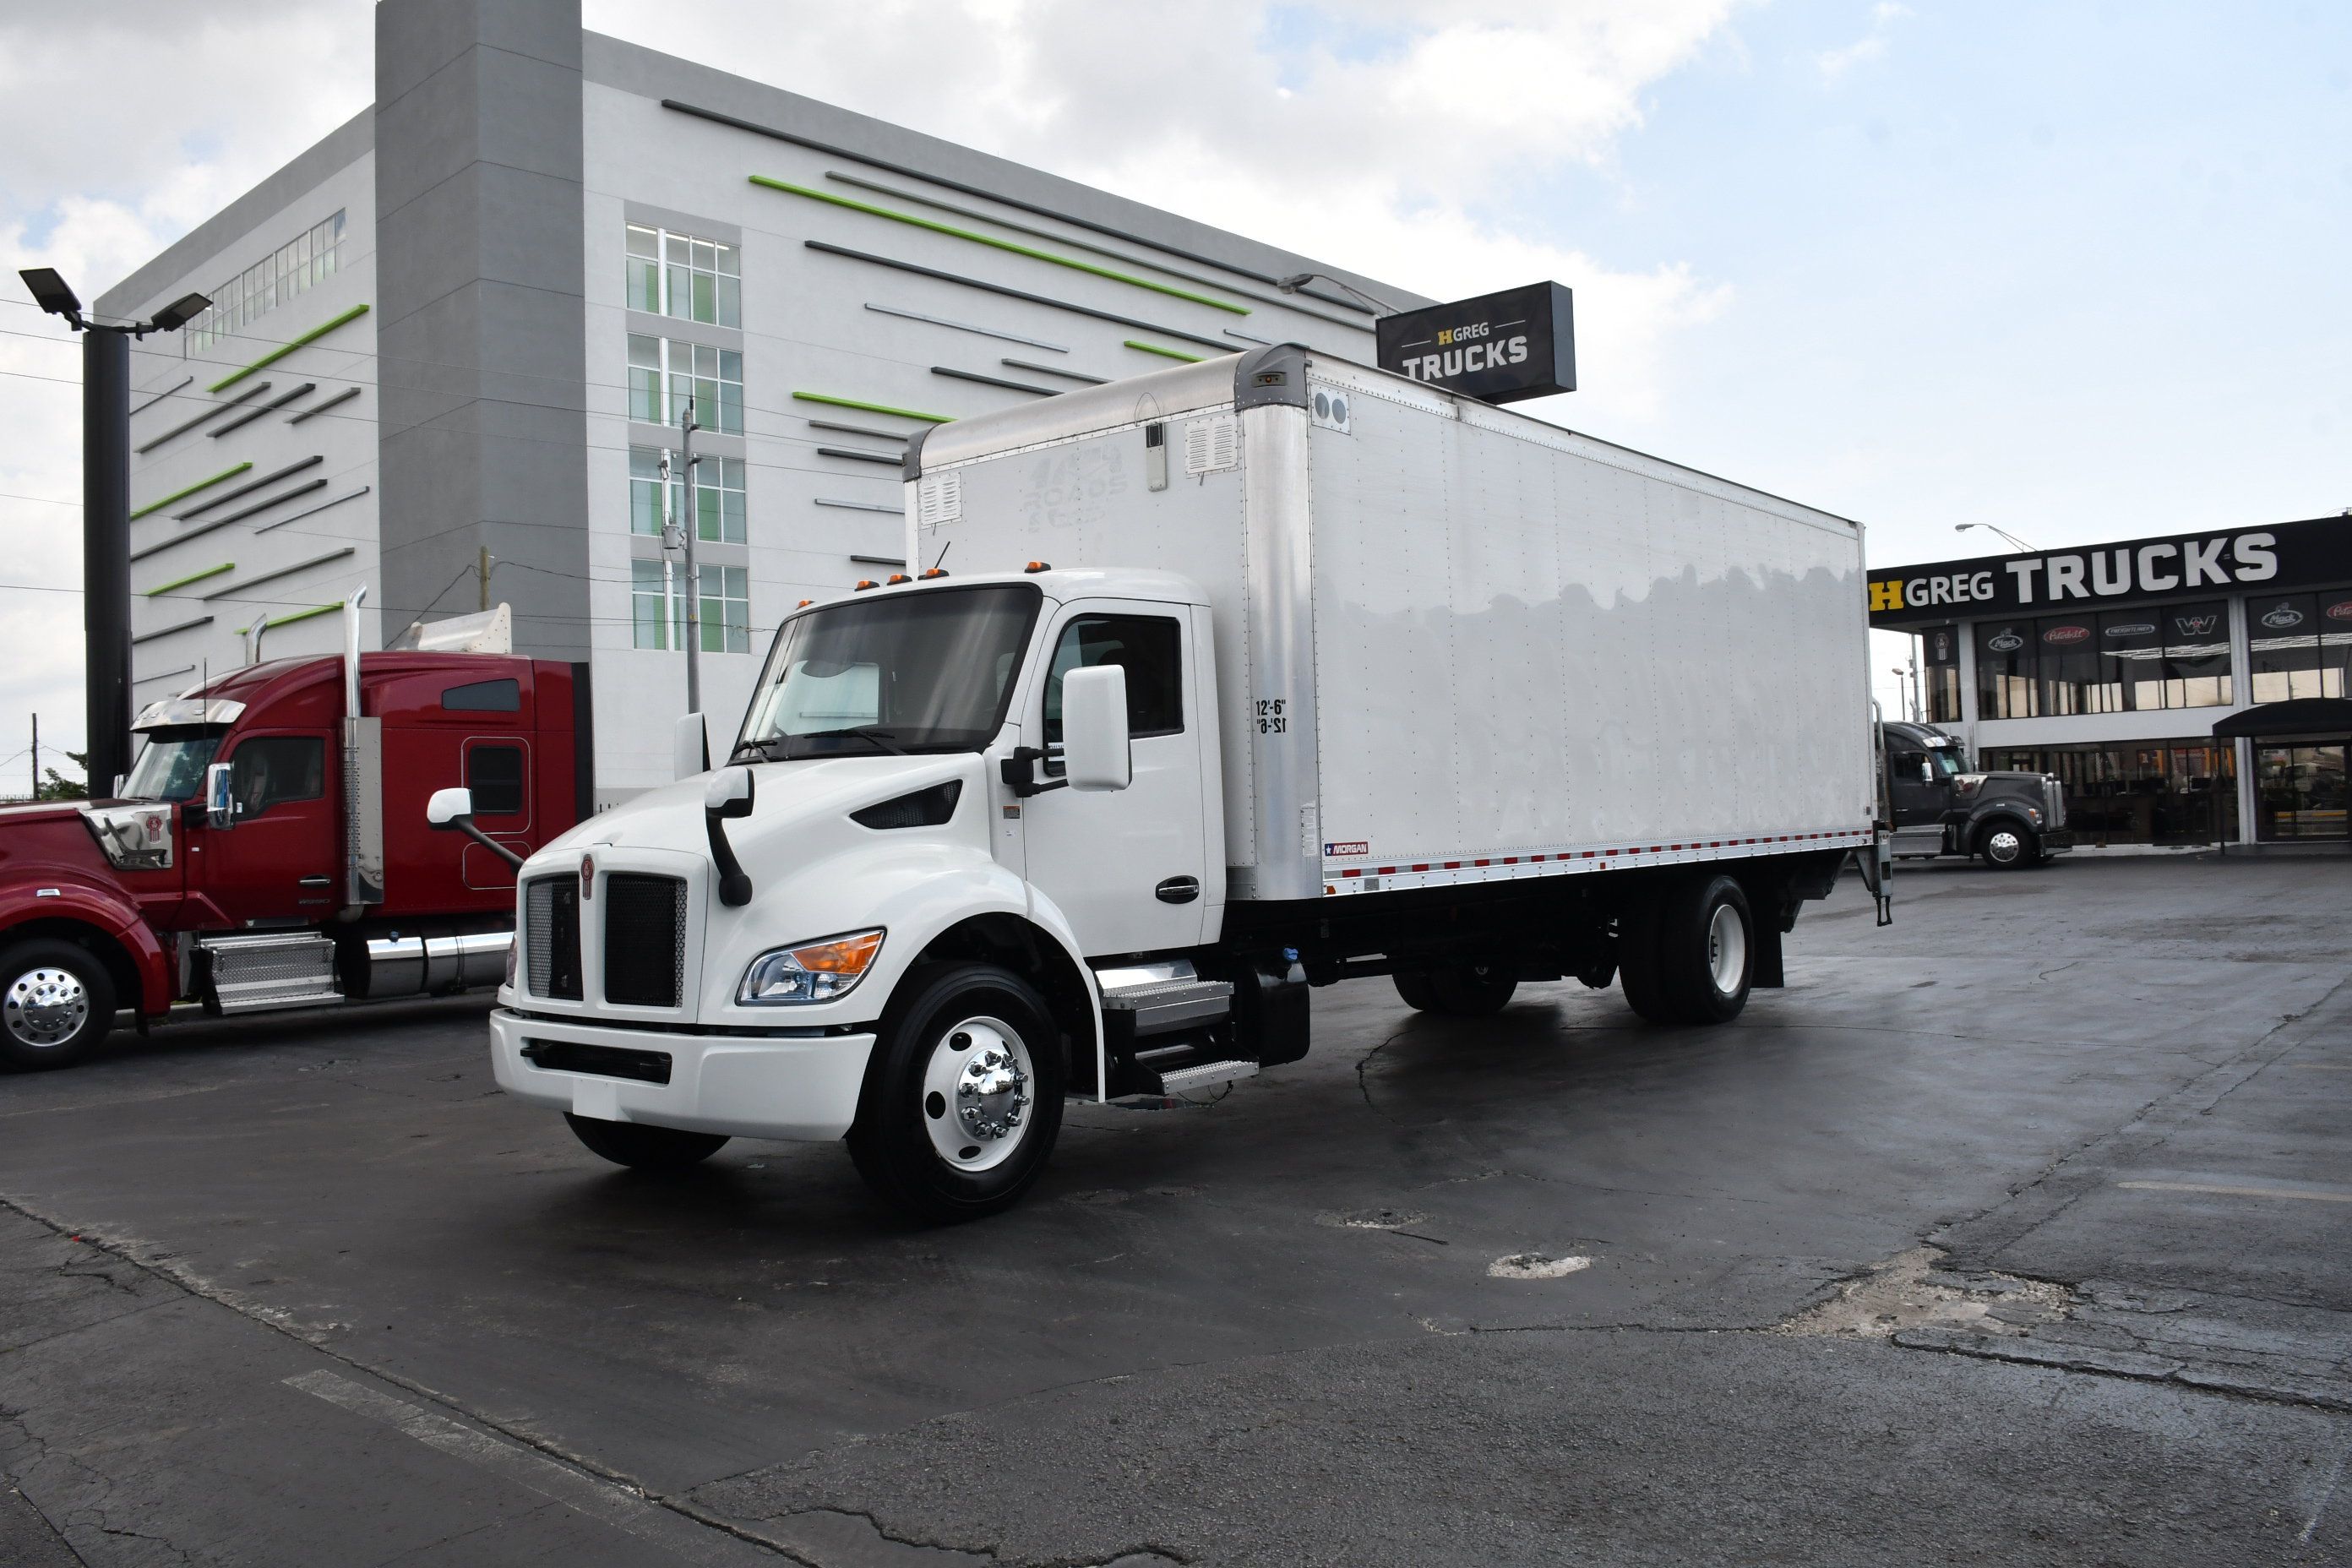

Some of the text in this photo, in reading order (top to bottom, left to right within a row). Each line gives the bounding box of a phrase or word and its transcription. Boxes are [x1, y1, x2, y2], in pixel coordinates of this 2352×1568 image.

[1402, 335, 1527, 380] TRUCKS
[2006, 532, 2278, 604] TRUCKS
[2269, 613, 2295, 624] Mack
[2050, 629, 2086, 640] Peterbilt
[2110, 625, 2150, 634] FREIGHTLINER
[1995, 638, 2017, 649] Mack
[1256, 700, 1286, 716] 12'-6"
[1333, 844, 1367, 854] MORGAN
